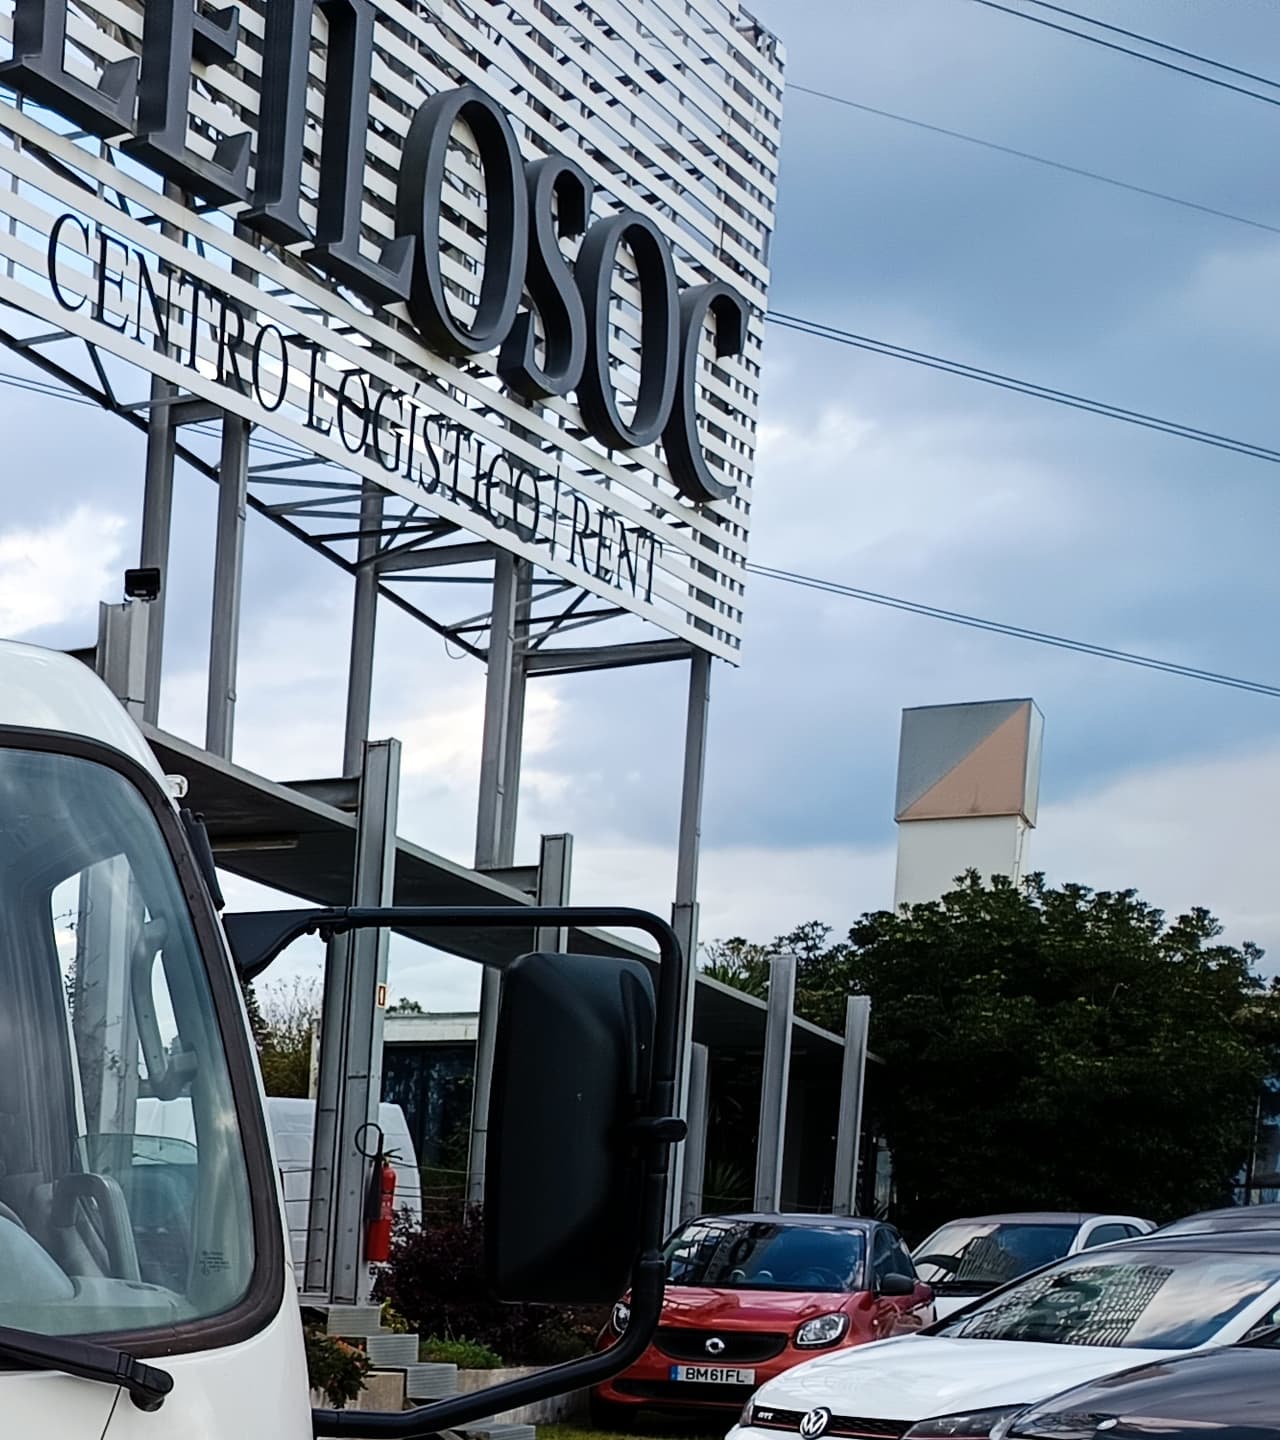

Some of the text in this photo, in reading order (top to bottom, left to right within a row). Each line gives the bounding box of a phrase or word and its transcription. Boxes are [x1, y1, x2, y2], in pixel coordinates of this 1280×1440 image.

[48, 214, 288, 412] CENTRO
[302, 346, 539, 543] LOGÍSTICO
[567, 491, 663, 605] RENT
